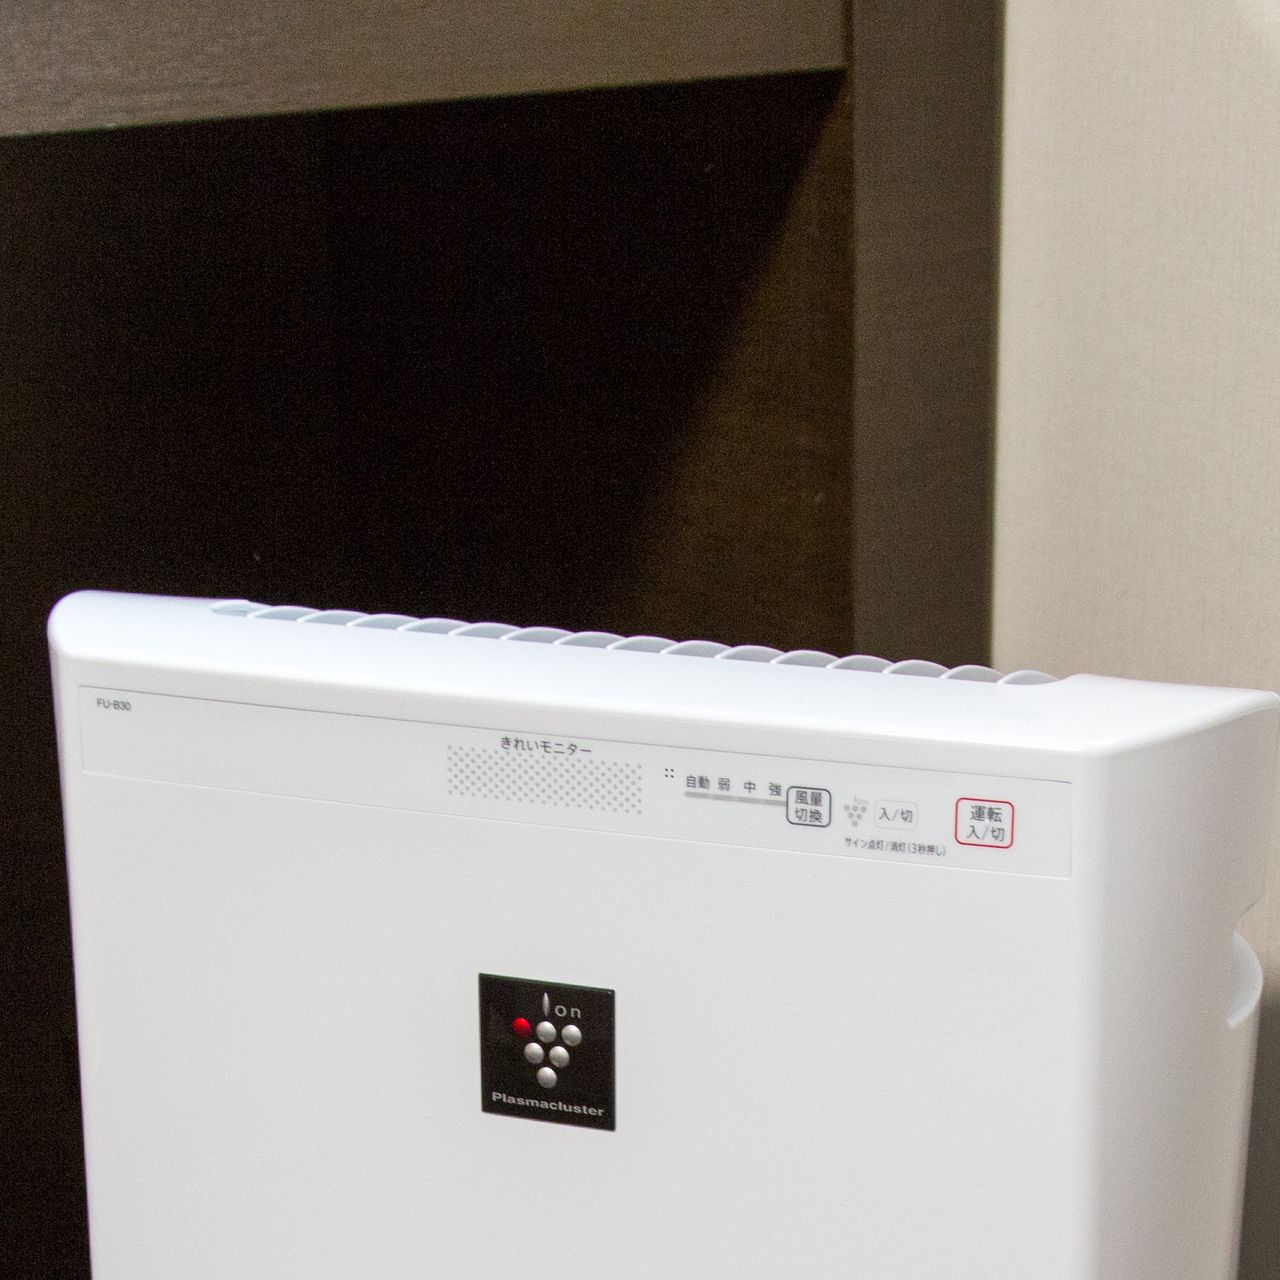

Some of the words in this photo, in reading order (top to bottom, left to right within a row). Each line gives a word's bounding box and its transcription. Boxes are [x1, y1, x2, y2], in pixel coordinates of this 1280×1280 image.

[501, 736, 592, 756] きれいモニター
[686, 775, 710, 789] 自動
[718, 777, 731, 791] 弱
[743, 780, 756, 793] 中
[768, 782, 782, 796] 強
[795, 790, 823, 806] 風量
[794, 808, 823, 823] 切換
[878, 808, 913, 823] 入/切
[969, 805, 1003, 822] 運転
[966, 825, 1005, 842] 入/切
[491, 1091, 605, 1117] Plasmacluster
